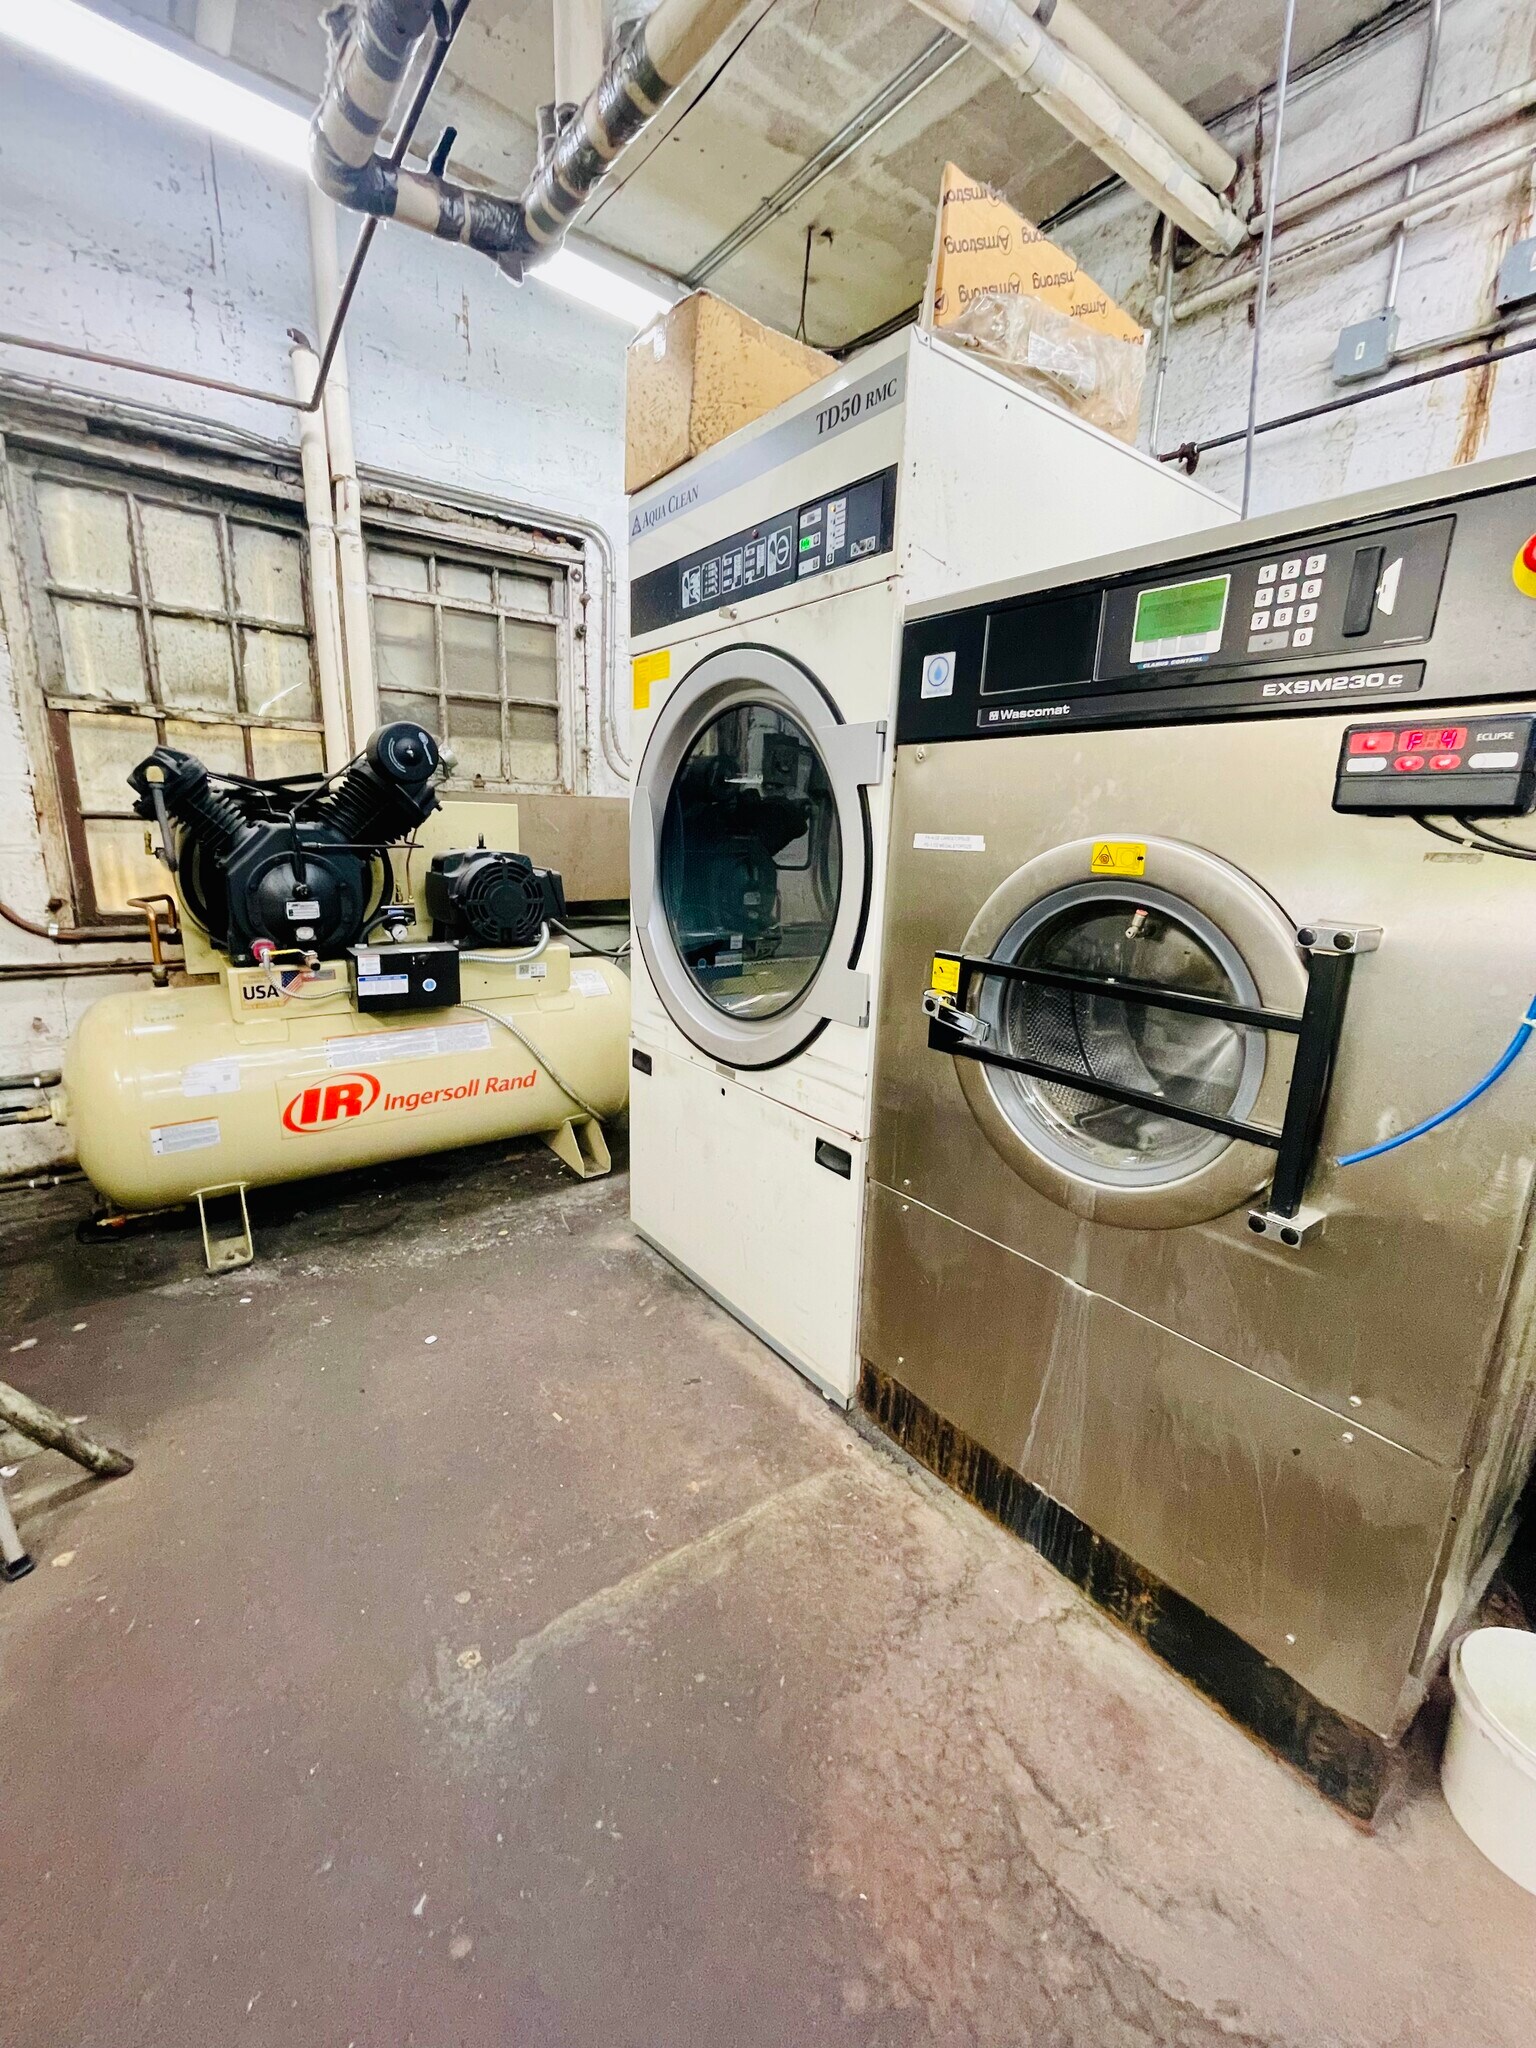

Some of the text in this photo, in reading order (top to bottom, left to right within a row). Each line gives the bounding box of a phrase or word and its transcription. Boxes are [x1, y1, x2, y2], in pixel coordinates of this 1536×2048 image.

[944, 233, 1010, 254] Armstrong
[816, 378, 897, 435] TD50 RMC
[668, 484, 699, 514] CLEAN
[1287, 565, 1296, 575] 2
[1311, 560, 1320, 570] 3
[1283, 589, 1291, 598] 5
[1307, 584, 1315, 594] 6
[1279, 612, 1287, 622] 8
[1303, 609, 1311, 618] 9
[1299, 632, 1306, 642] 0
[1170, 655, 1204, 666] CONTROL
[1262, 672, 1385, 697] EXSM230
[1000, 704, 1070, 720] Wascomat
[1407, 729, 1457, 751] F 4
[1476, 731, 1515, 743] ECLIPSE
[242, 985, 279, 1000] USA
[383, 1069, 537, 1112] Ingersoll Rand
[300, 1082, 364, 1125] IR
